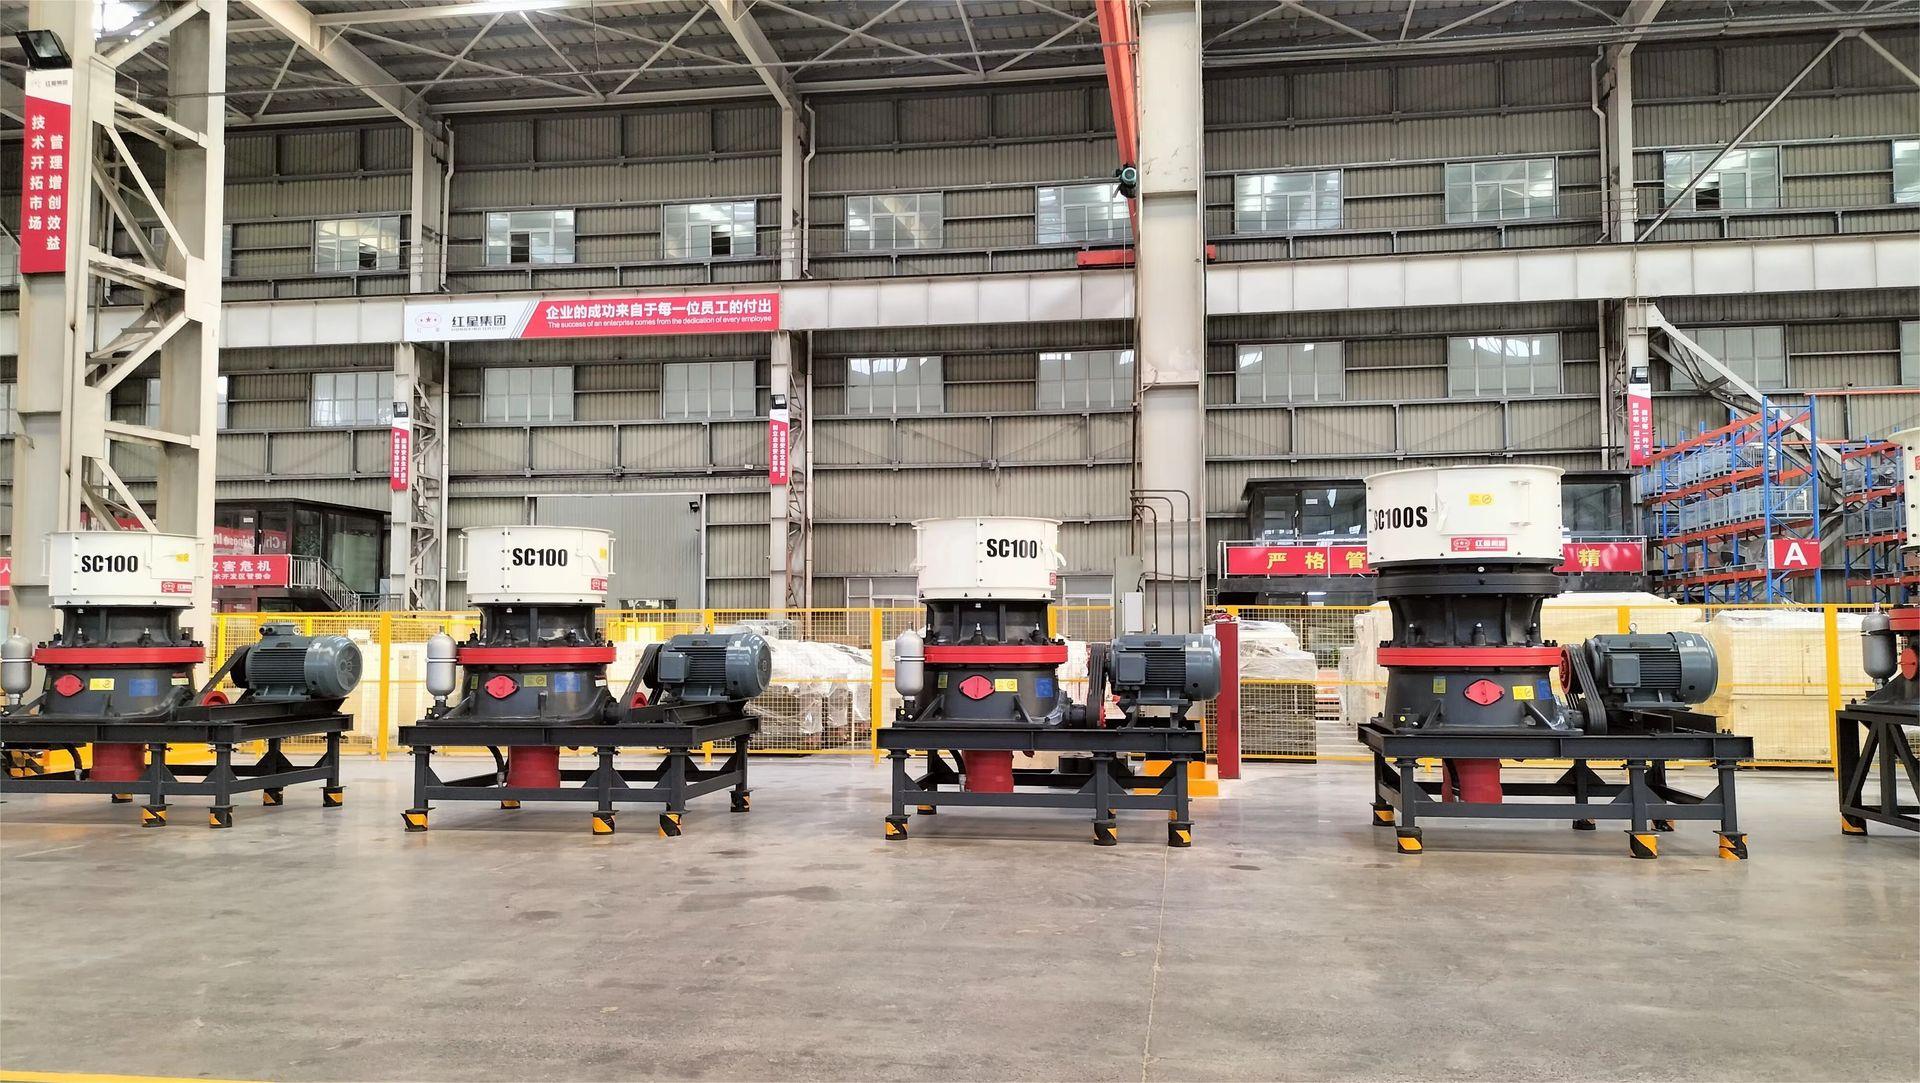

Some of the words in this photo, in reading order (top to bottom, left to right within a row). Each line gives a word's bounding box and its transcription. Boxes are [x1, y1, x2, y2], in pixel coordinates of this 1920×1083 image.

[28, 115, 45, 230] 技术开拓市场
[46, 135, 64, 250] 管理增创效益
[546, 299, 772, 320] 企业的成功来自于每一位员工的付出
[451, 315, 506, 327] 红星集团
[548, 321, 559, 329] The
[603, 319, 634, 328] enterprise
[683, 316, 715, 325] dedication
[723, 316, 740, 324] every
[741, 315, 772, 324] employee
[1373, 506, 1428, 531] SC100S
[81, 554, 139, 573] SC100
[512, 548, 568, 567] SC100
[1578, 549, 1600, 567] 精
[1783, 542, 1808, 566] A
